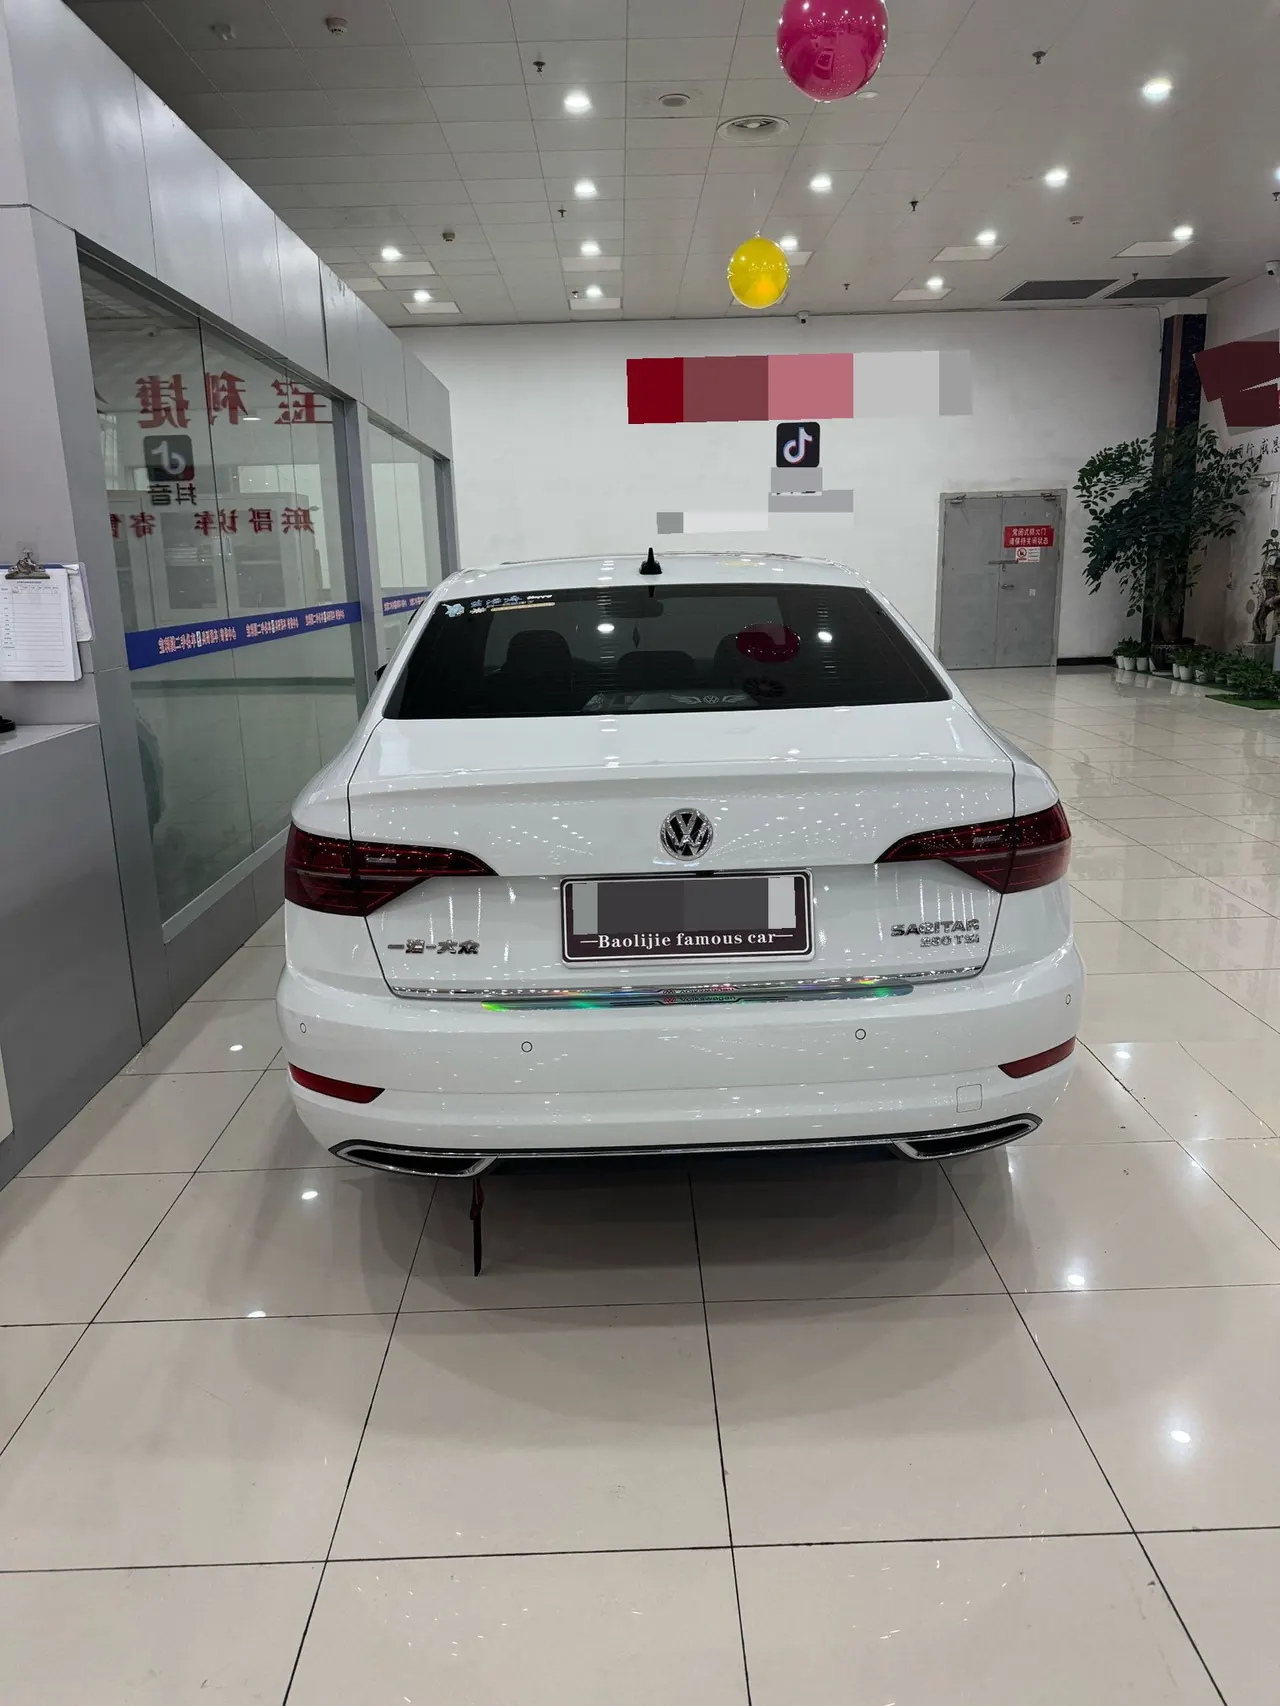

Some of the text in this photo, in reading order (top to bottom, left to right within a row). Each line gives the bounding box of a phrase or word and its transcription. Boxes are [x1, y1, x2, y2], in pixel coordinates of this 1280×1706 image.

[890, 918, 980, 937] SAGITAR
[598, 932, 776, 950] Baolijie famous car
